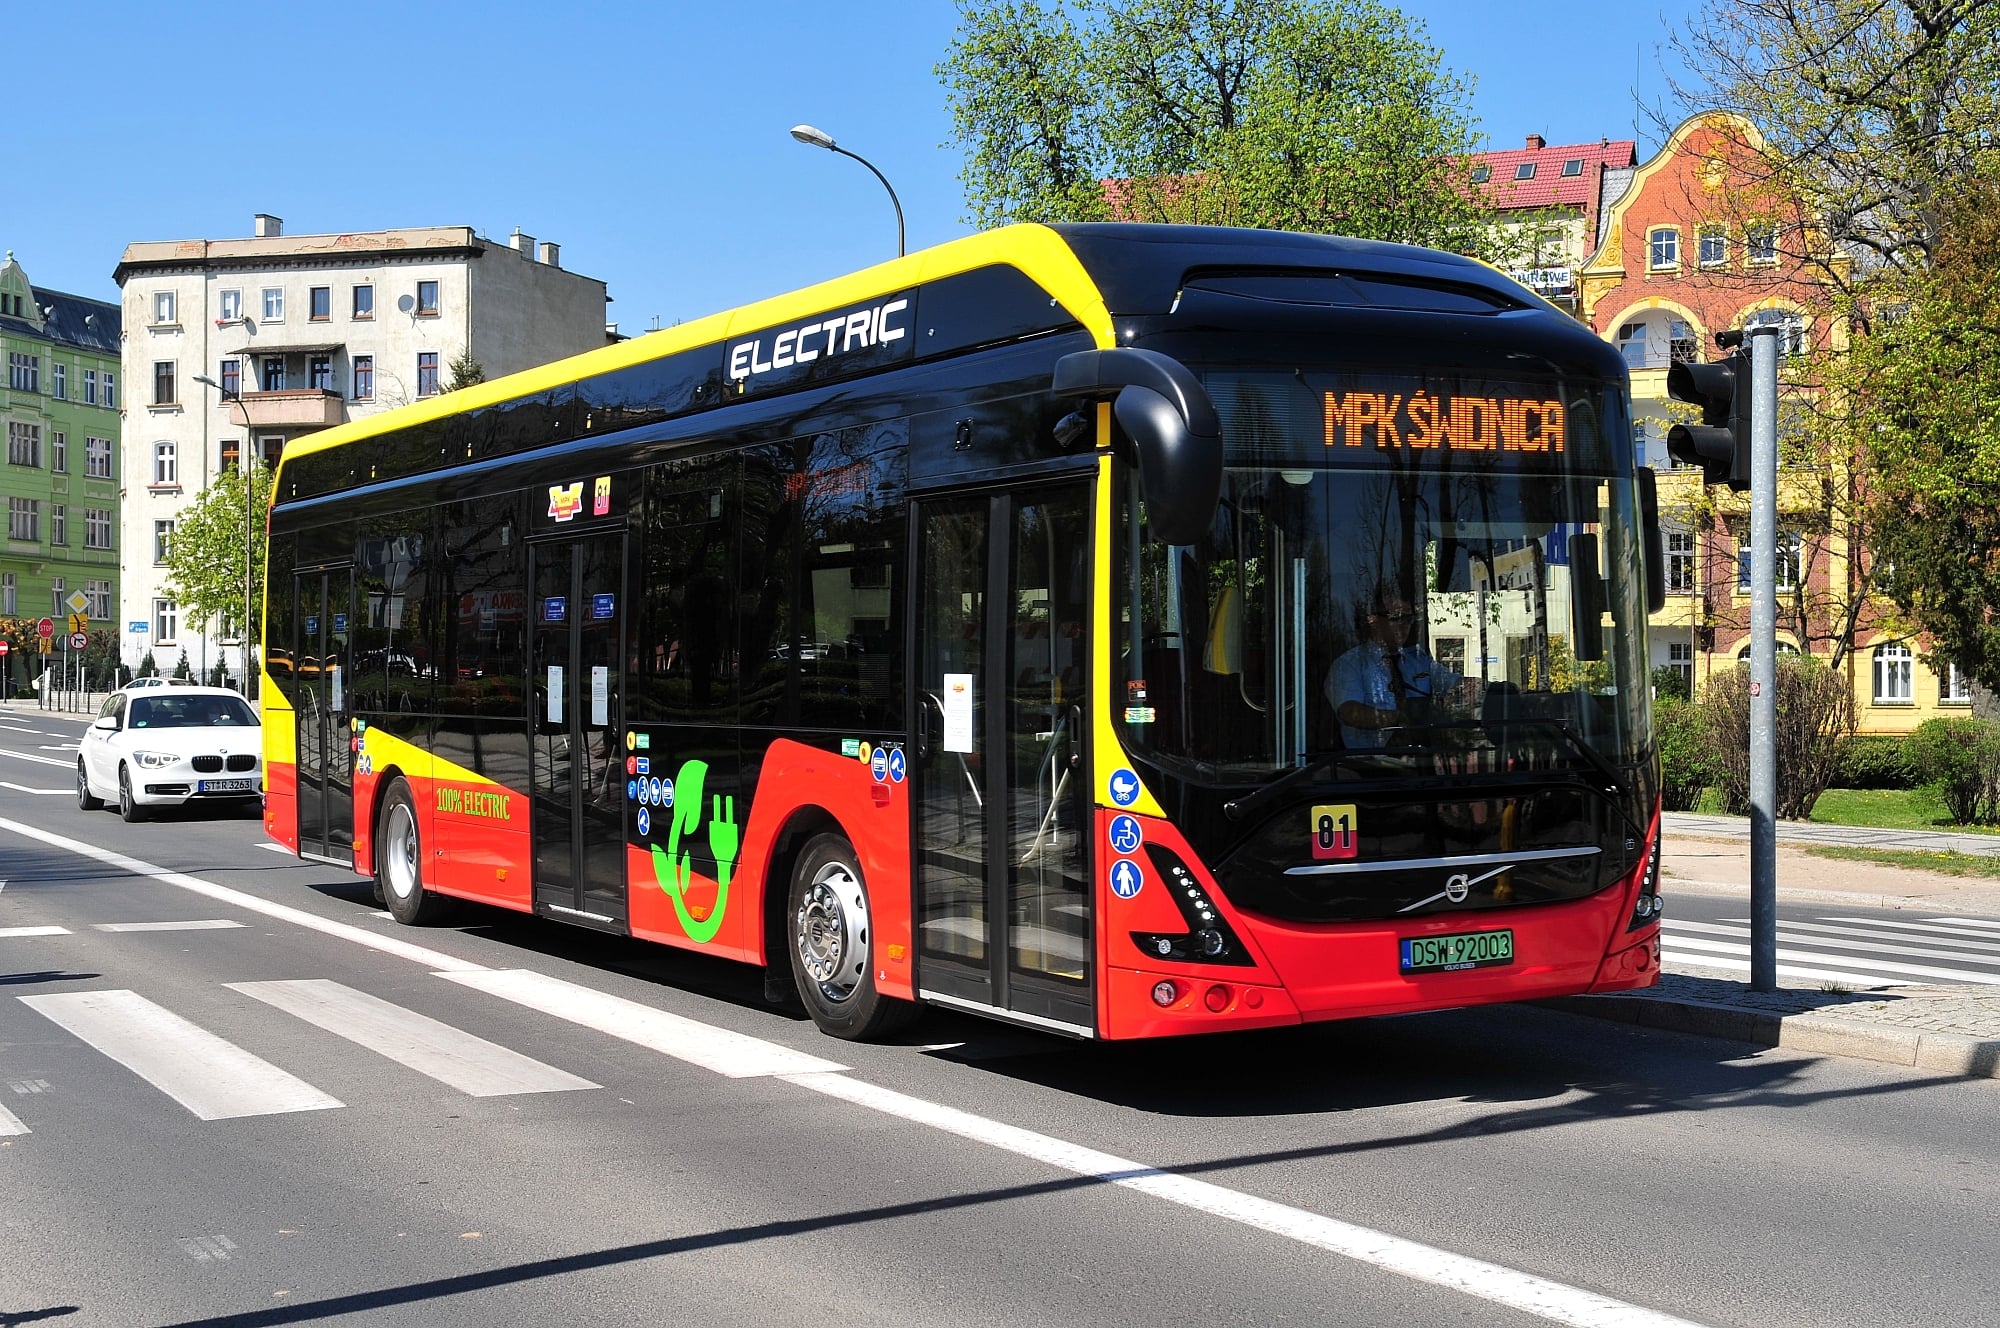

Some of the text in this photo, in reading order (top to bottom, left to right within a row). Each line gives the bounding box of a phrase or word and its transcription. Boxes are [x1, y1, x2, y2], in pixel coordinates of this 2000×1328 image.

[730, 299, 907, 380] ELECTRIC
[1325, 389, 1564, 452] MPK ŚWIDNICA
[597, 484, 608, 508] 81
[229, 780, 250, 790] 3263
[436, 787, 511, 820] 100% ELECTRIC
[1317, 813, 1350, 849] 81
[1412, 933, 1510, 966] DSW 92003
